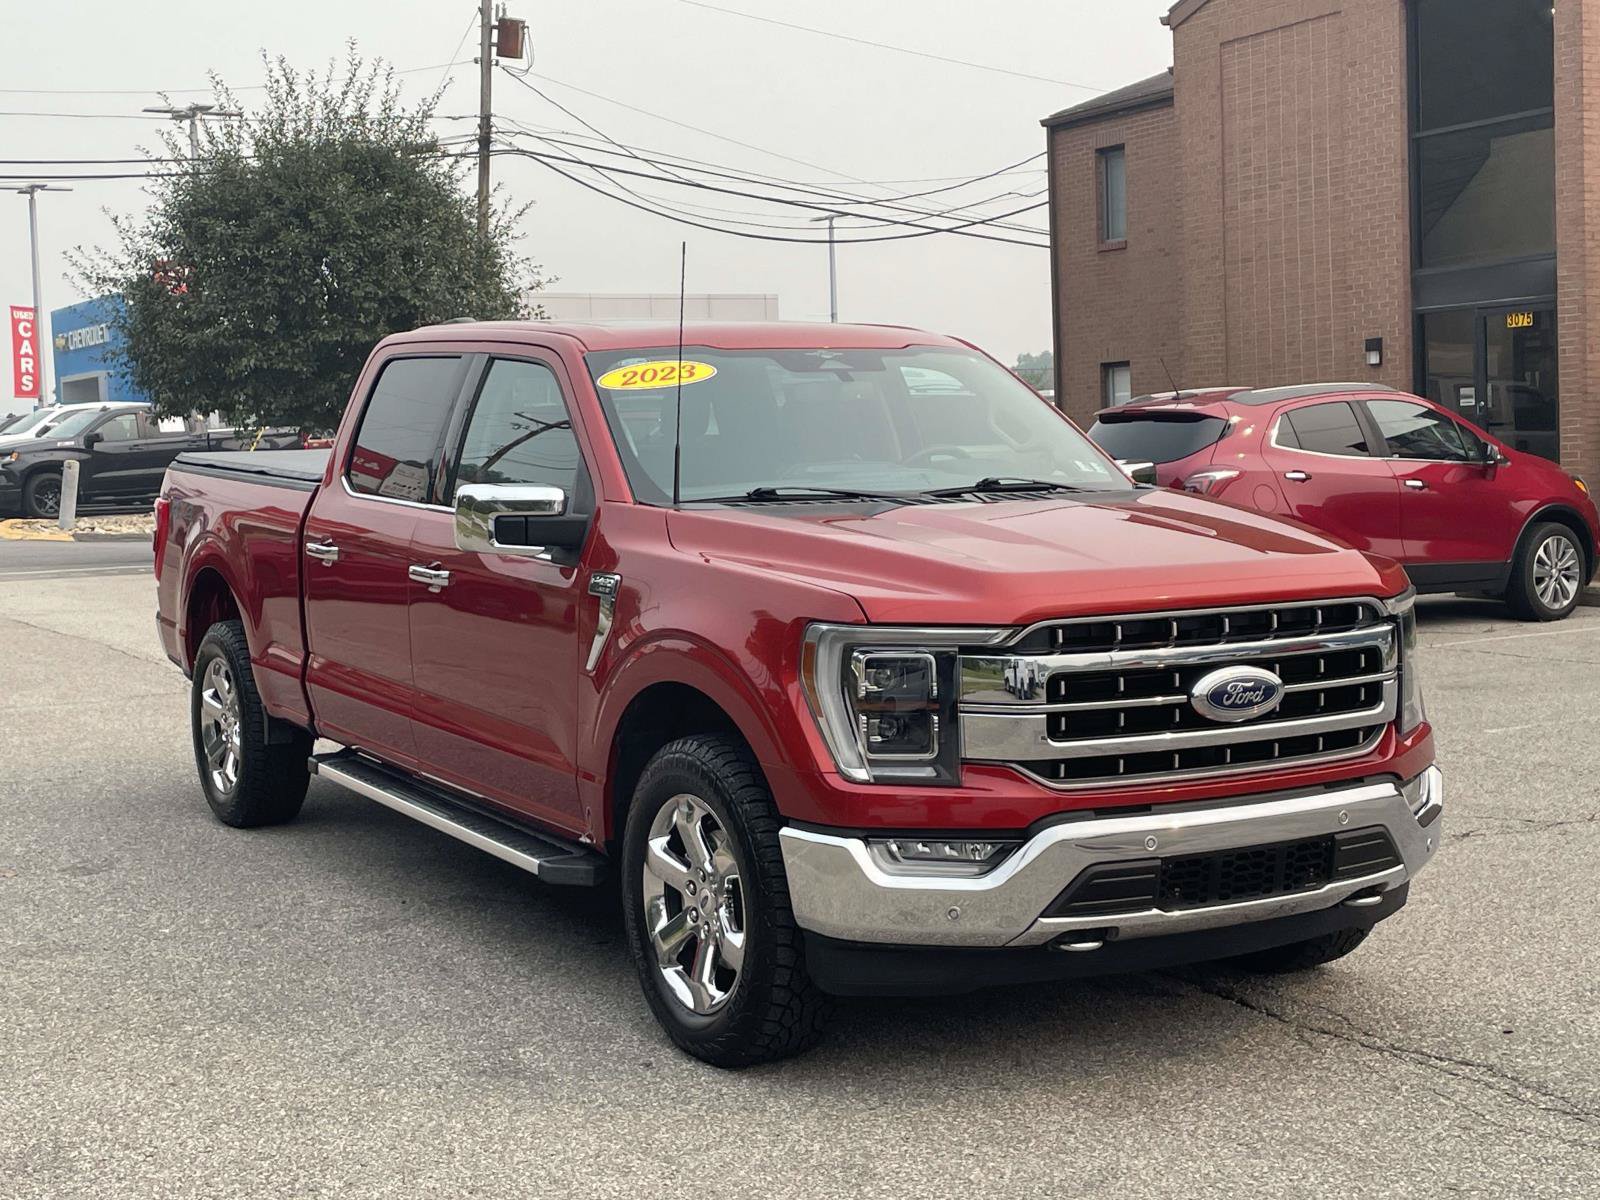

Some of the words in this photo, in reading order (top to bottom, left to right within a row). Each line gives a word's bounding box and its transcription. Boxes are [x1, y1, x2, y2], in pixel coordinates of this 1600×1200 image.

[13, 310, 34, 320] USED
[1508, 313, 1532, 326] 3075
[68, 324, 107, 350] CHEVROLET
[18, 321, 34, 392] CARS
[621, 364, 696, 386] 2023
[1222, 681, 1266, 706] Ford
